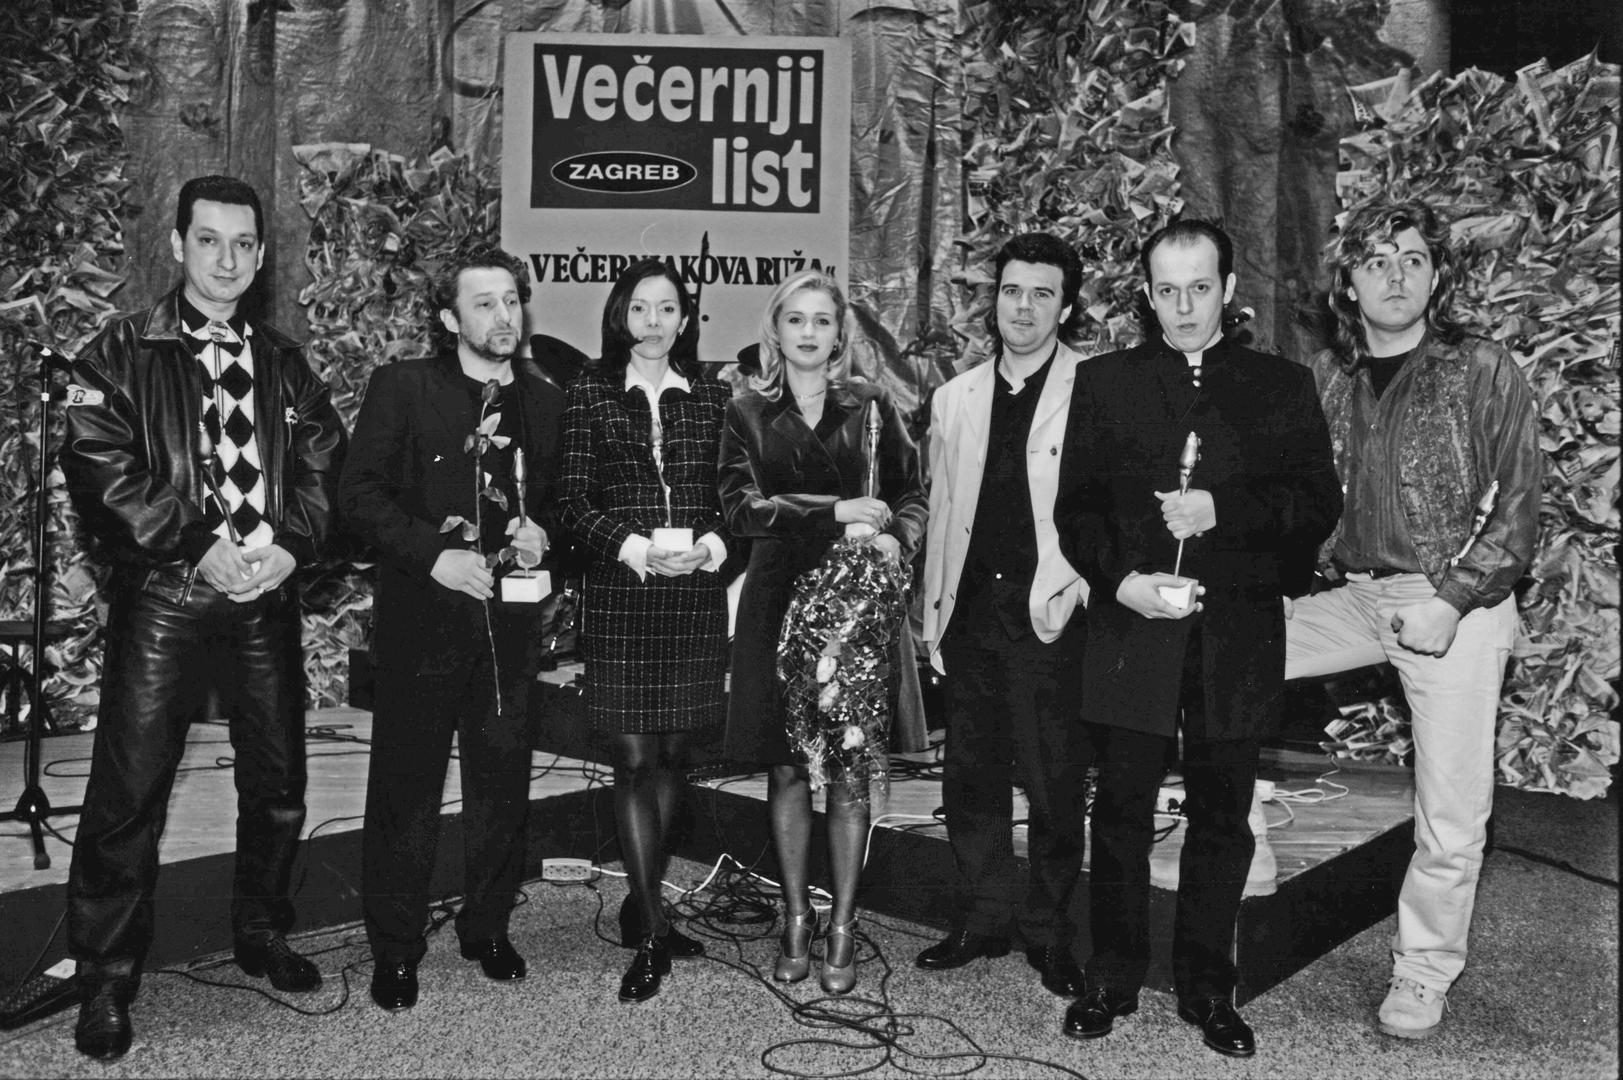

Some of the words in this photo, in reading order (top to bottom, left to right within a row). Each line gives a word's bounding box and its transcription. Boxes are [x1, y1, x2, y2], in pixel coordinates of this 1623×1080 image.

[542, 54, 816, 136] Večernji
[569, 163, 680, 181] ZAGREB
[711, 136, 814, 208] list
